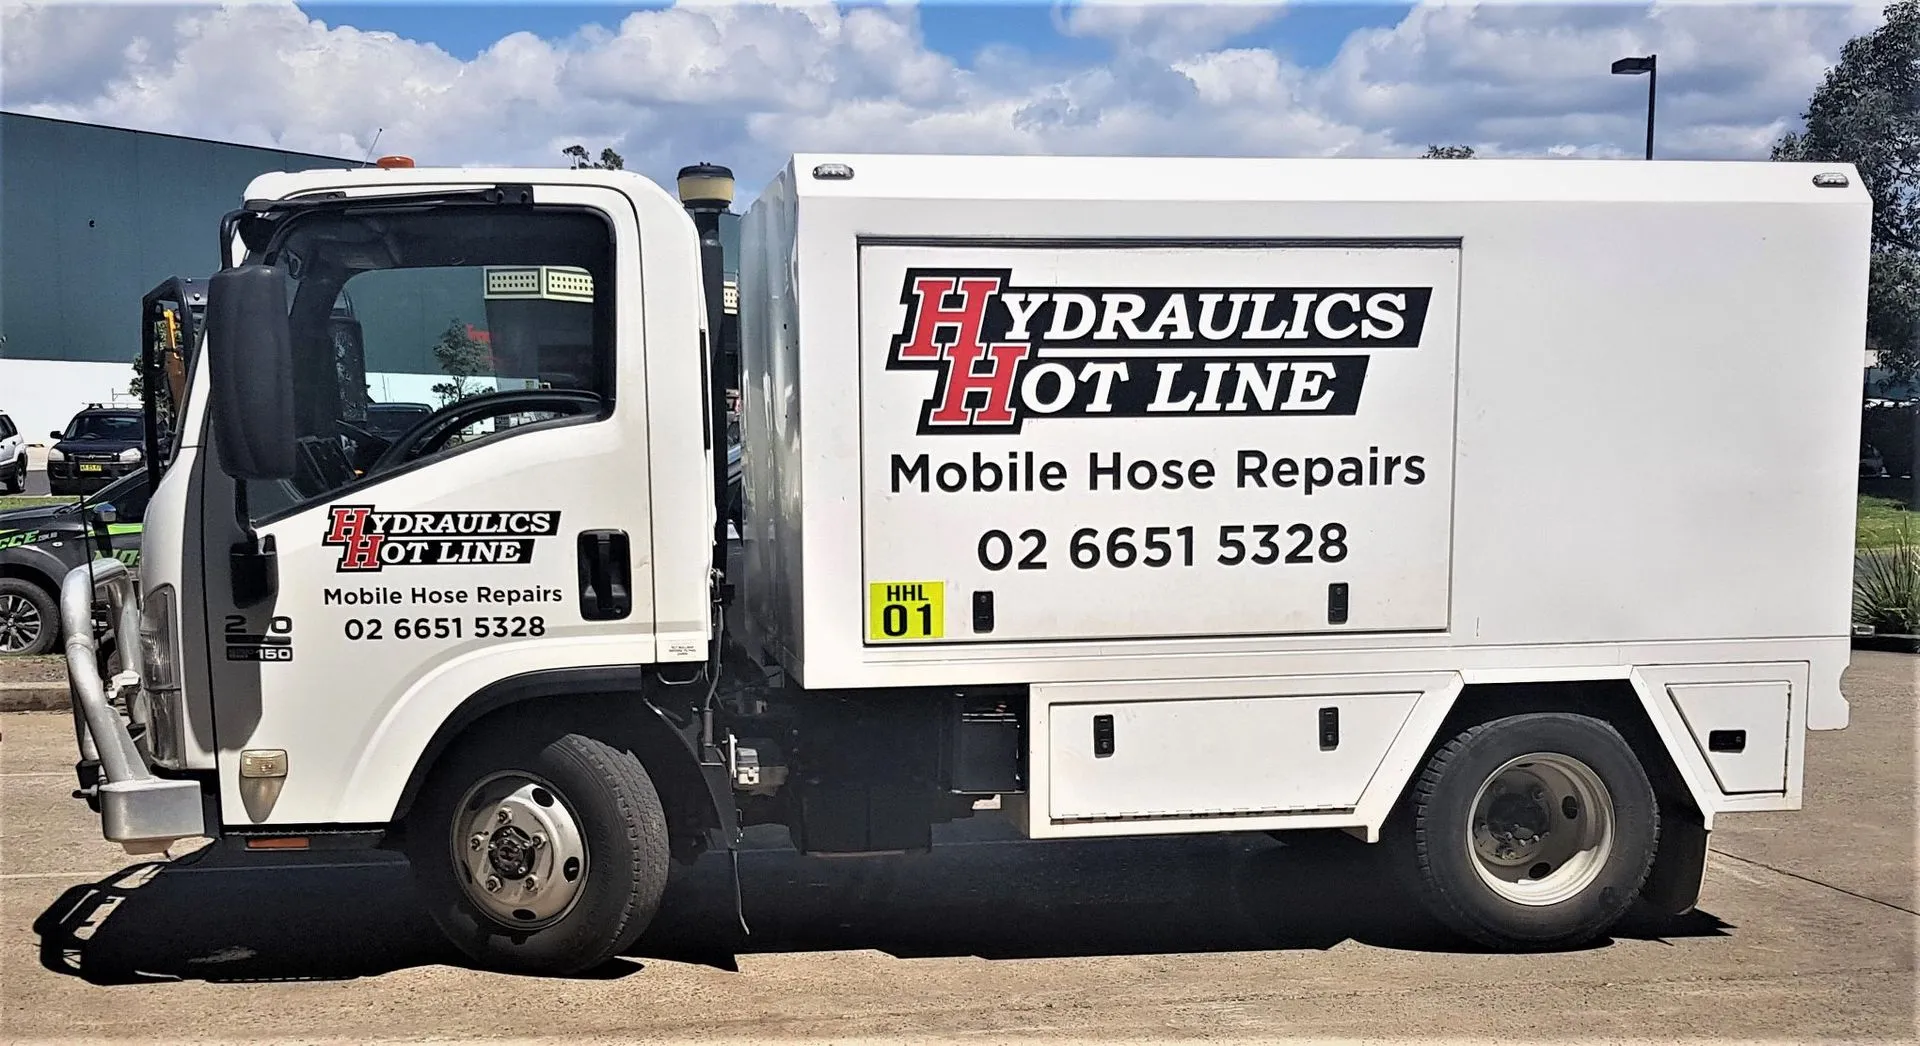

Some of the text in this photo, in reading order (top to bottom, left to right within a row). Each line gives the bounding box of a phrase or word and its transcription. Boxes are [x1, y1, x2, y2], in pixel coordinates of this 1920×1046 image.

[899, 277, 1407, 360] HYDRAULICS
[929, 343, 1338, 425] HOT LINE
[890, 447, 1426, 496] Mobile Hose Repairs
[327, 509, 552, 542] HYDRAULICS
[342, 534, 521, 569] HOT LINE
[977, 522, 1349, 571] 02 6651 5328
[324, 585, 562, 606] Mobile Hose Repairs
[887, 585, 929, 601] HHL
[225, 615, 292, 634] 20
[344, 616, 545, 640] 02 6651 5328
[883, 603, 932, 636] 01
[256, 648, 291, 659] 150
